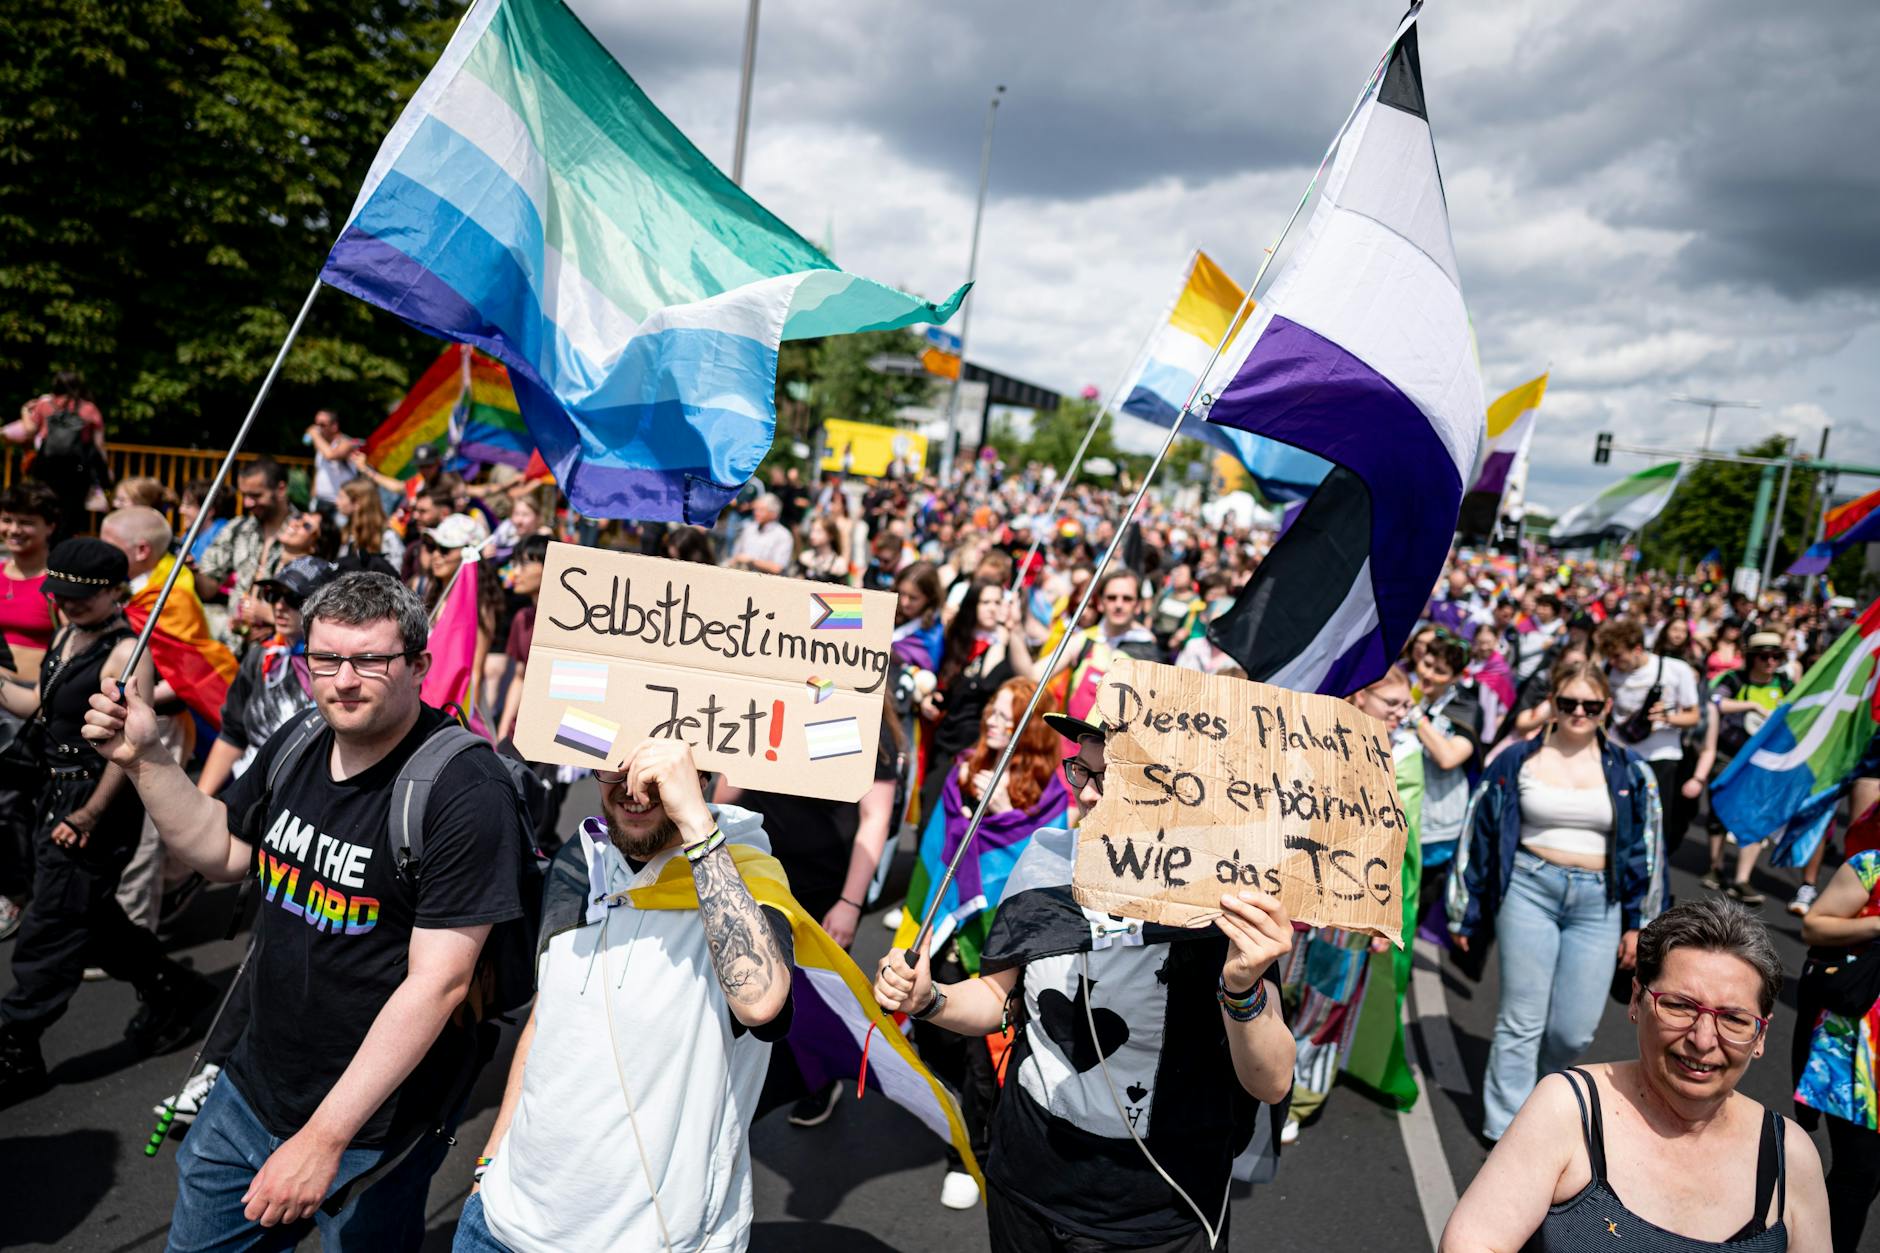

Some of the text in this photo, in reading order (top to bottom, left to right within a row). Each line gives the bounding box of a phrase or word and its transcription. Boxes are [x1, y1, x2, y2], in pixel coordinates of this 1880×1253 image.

[549, 567, 890, 693] Selbstbestimmung
[645, 684, 785, 762] Jetzt!
[1108, 682, 1228, 741] Dieses
[1226, 772, 1408, 832] erbärmlich
[264, 808, 373, 889] AM THE
[1216, 849, 1282, 896] das
[1284, 834, 1392, 906] TSG
